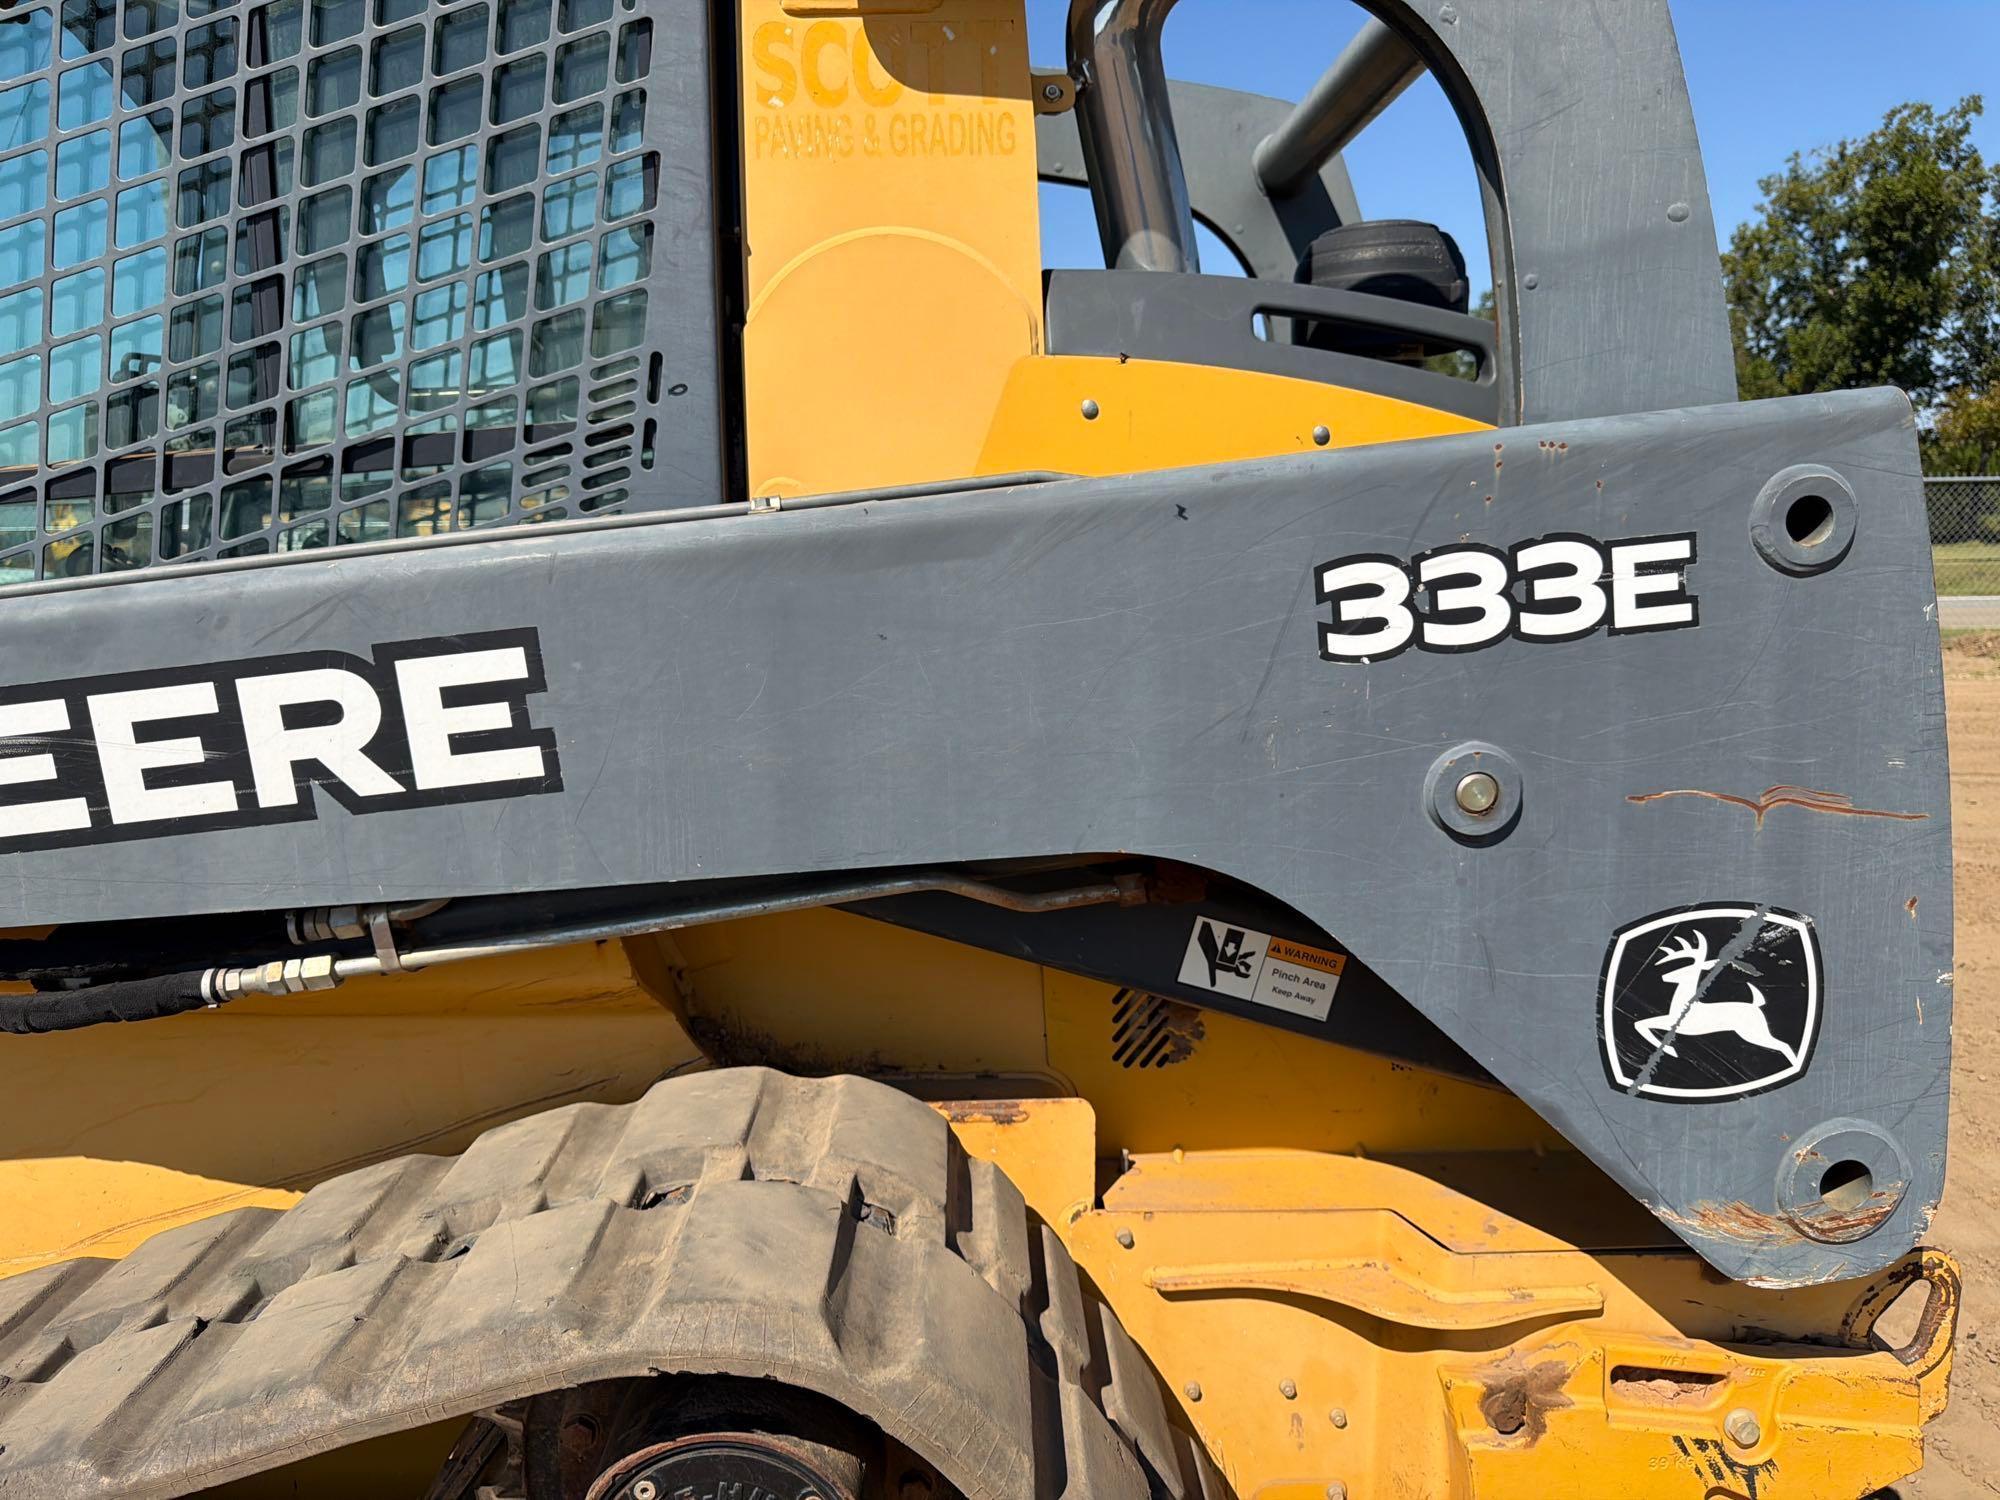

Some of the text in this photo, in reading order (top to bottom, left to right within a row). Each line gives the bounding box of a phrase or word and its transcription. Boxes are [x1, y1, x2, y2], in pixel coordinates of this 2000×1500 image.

[752, 20, 1015, 108] SCOTT
[754, 109, 1016, 159] PAVING & GRADING
[1322, 539, 1694, 657] 333E
[1284, 946, 1337, 968] WARNING
[1272, 968, 1326, 990] Pinch Area
[1272, 986, 1316, 1004] Keep Away
